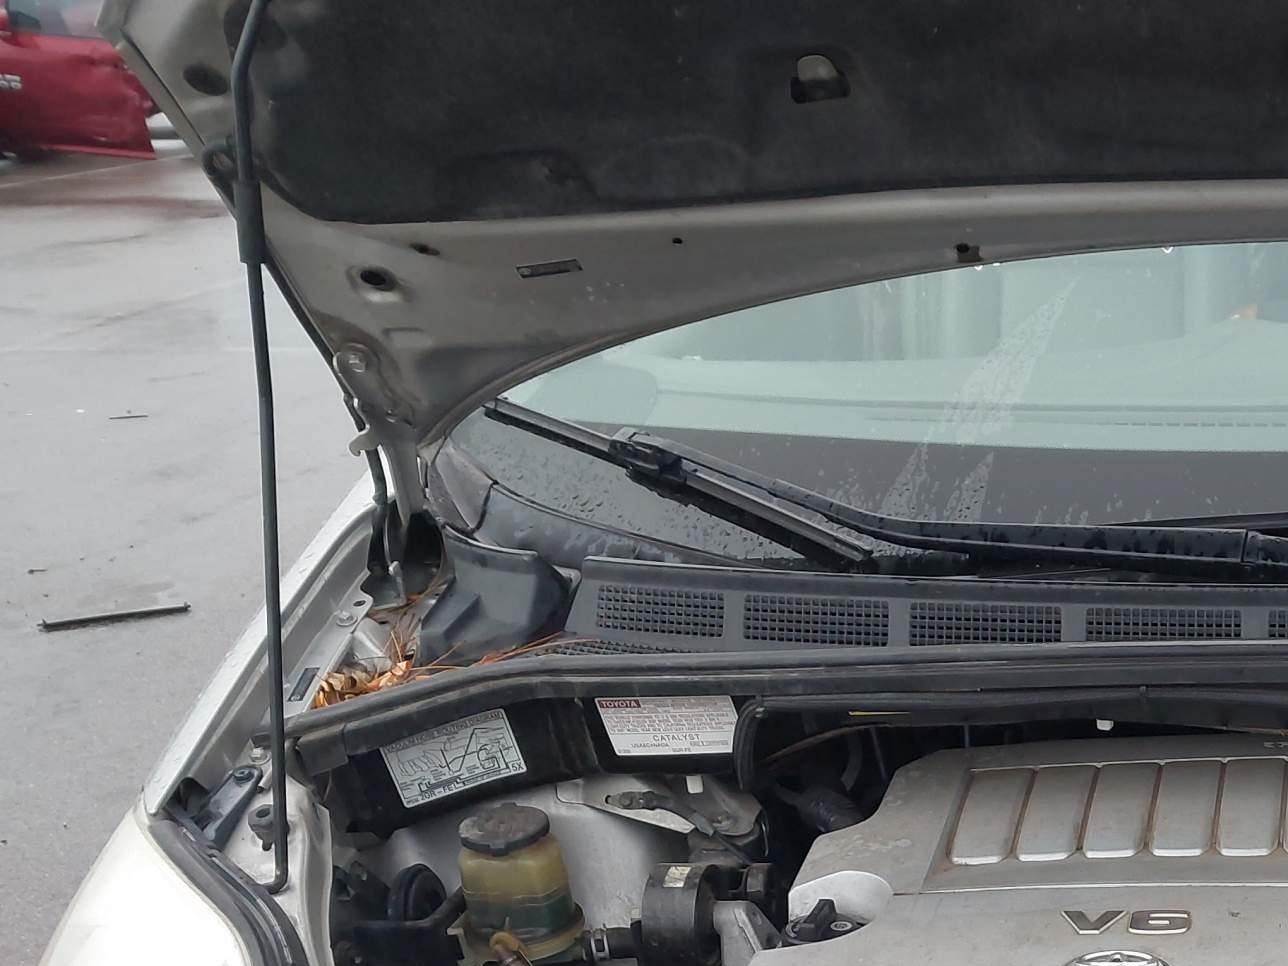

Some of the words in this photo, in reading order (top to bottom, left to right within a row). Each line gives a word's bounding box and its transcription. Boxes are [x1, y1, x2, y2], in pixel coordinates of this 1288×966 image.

[600, 699, 639, 708] TOYOTA
[652, 734, 702, 743] CATALYST
[510, 763, 525, 773] 5X
[1061, 909, 1193, 935] V6
